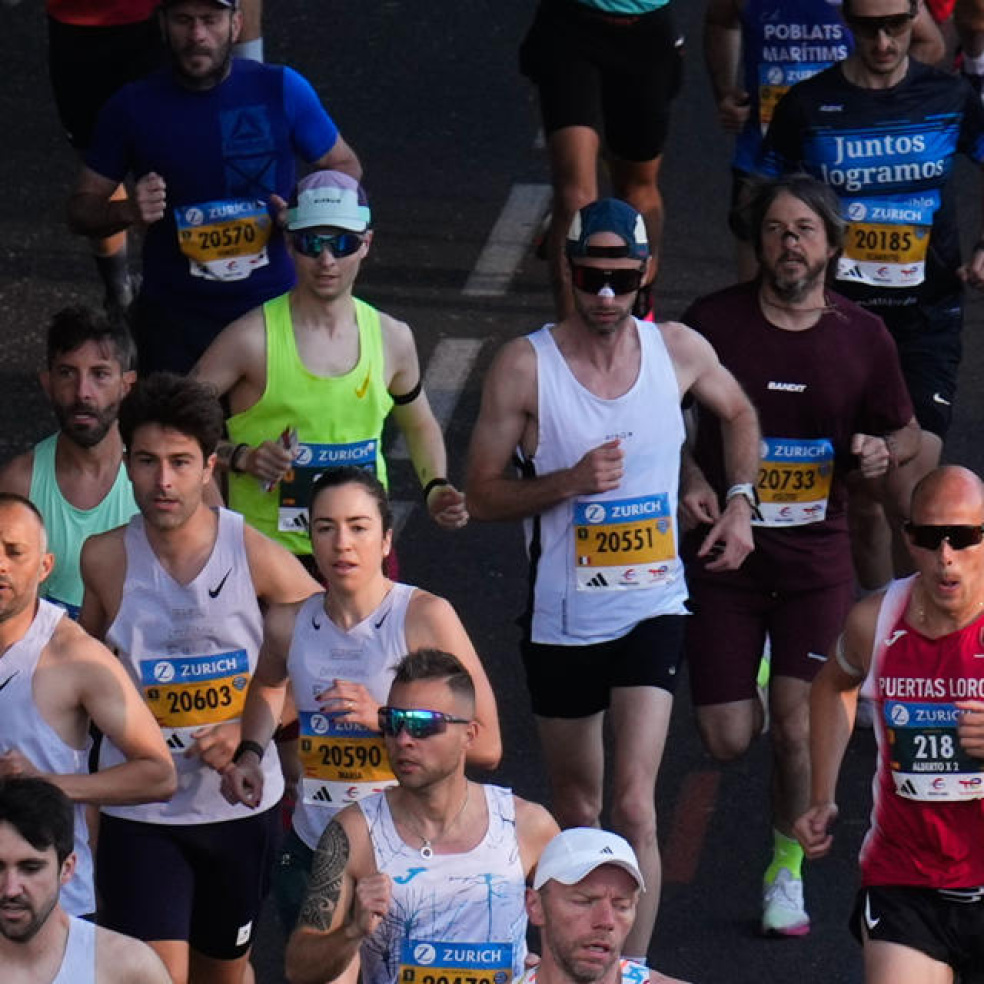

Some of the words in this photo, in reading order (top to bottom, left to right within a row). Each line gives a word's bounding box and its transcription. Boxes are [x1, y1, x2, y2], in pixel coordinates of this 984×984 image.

[764, 24, 843, 40] POBLATS
[834, 132, 926, 165] Juntos
[822, 156, 945, 190] logramos
[871, 206, 924, 220] ZURICH
[199, 222, 256, 250] 20570
[854, 227, 912, 251] 20185
[774, 444, 828, 457] ZURICH
[757, 467, 816, 490] 20733
[611, 501, 662, 518] ZURICH
[596, 527, 654, 553] 20551
[179, 657, 238, 677] ZURICH
[169, 684, 232, 715] 20603
[881, 677, 946, 699] PUERTAS
[916, 706, 962, 720] ZURIC
[319, 743, 382, 769] 20590
[914, 735, 954, 759] 218
[442, 947, 503, 963] ZURICH
